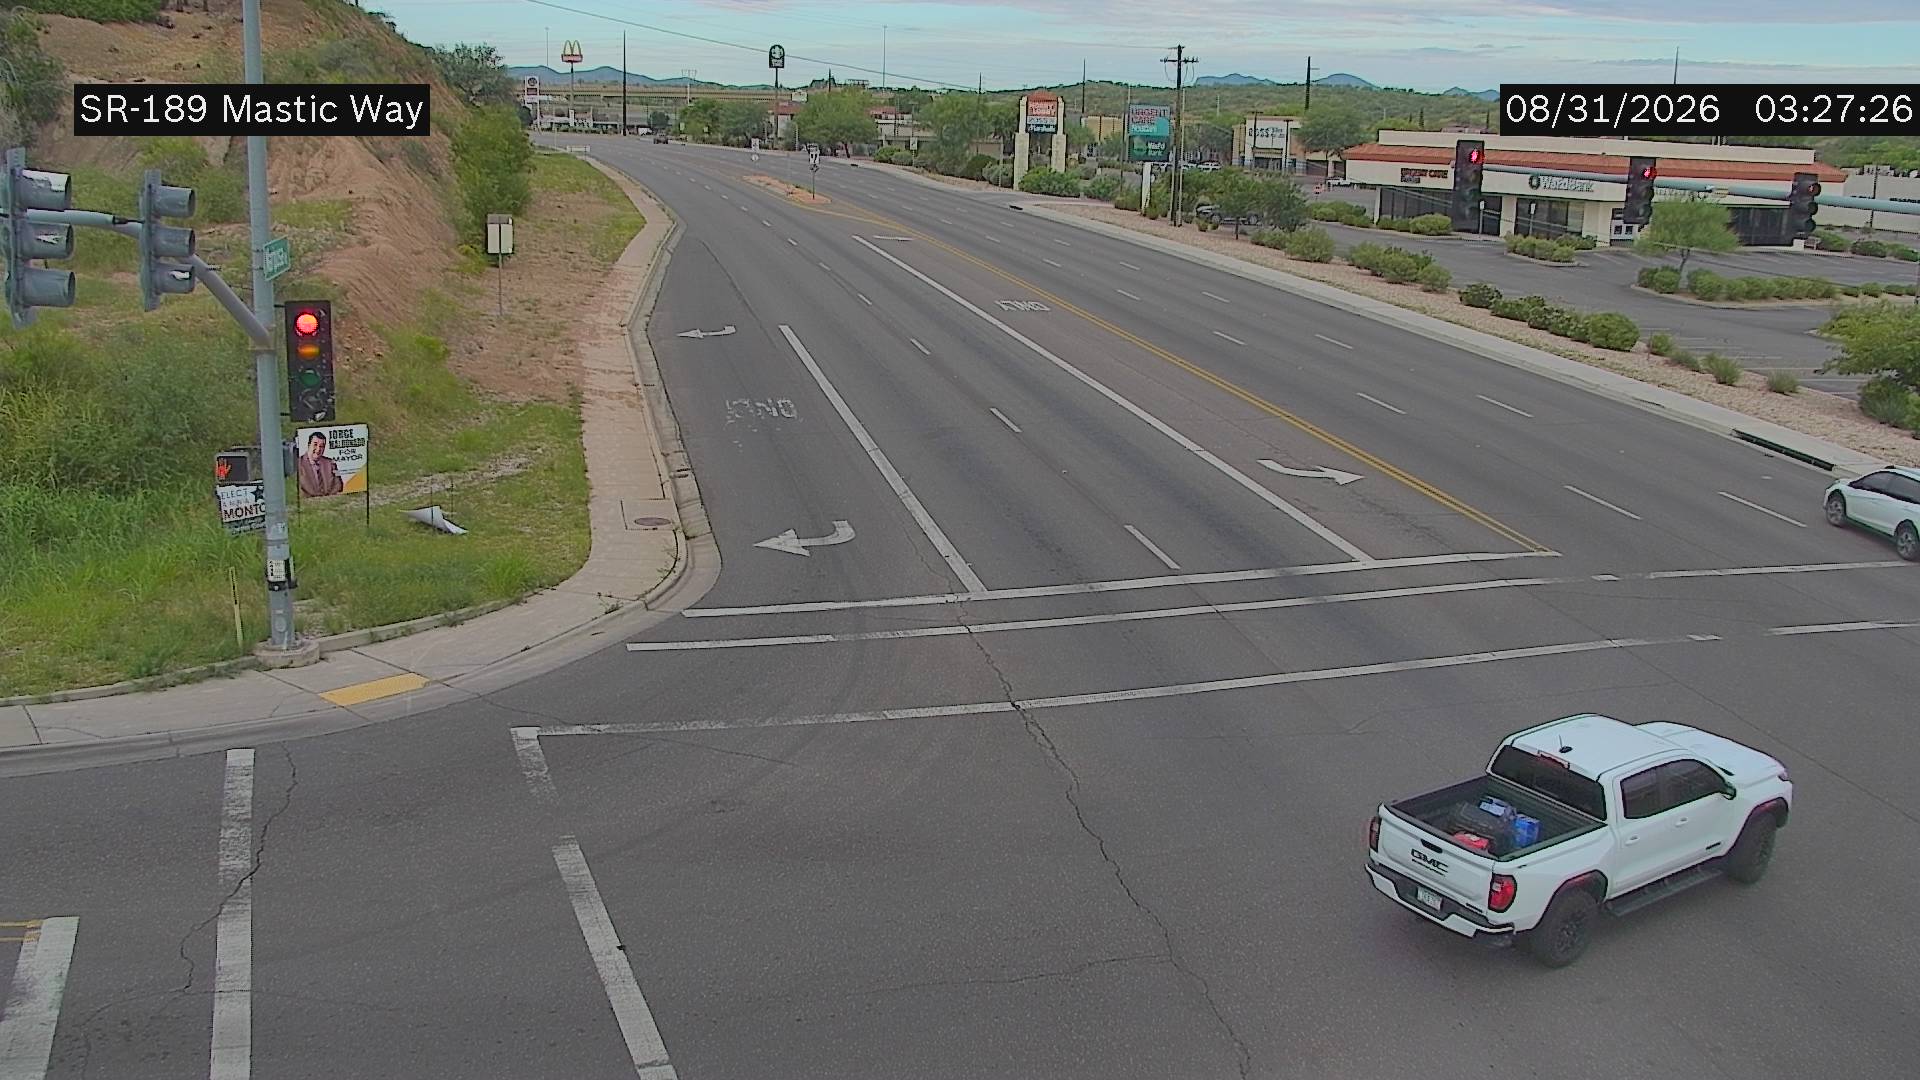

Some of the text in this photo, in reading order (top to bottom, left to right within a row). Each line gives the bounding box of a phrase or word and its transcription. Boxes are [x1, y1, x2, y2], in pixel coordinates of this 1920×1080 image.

[328, 429, 354, 440] JORGE
[339, 448, 357, 456] FOR
[332, 454, 363, 462] MAYOR
[221, 488, 248, 500] ELECT
[1411, 851, 1448, 873] GMC
